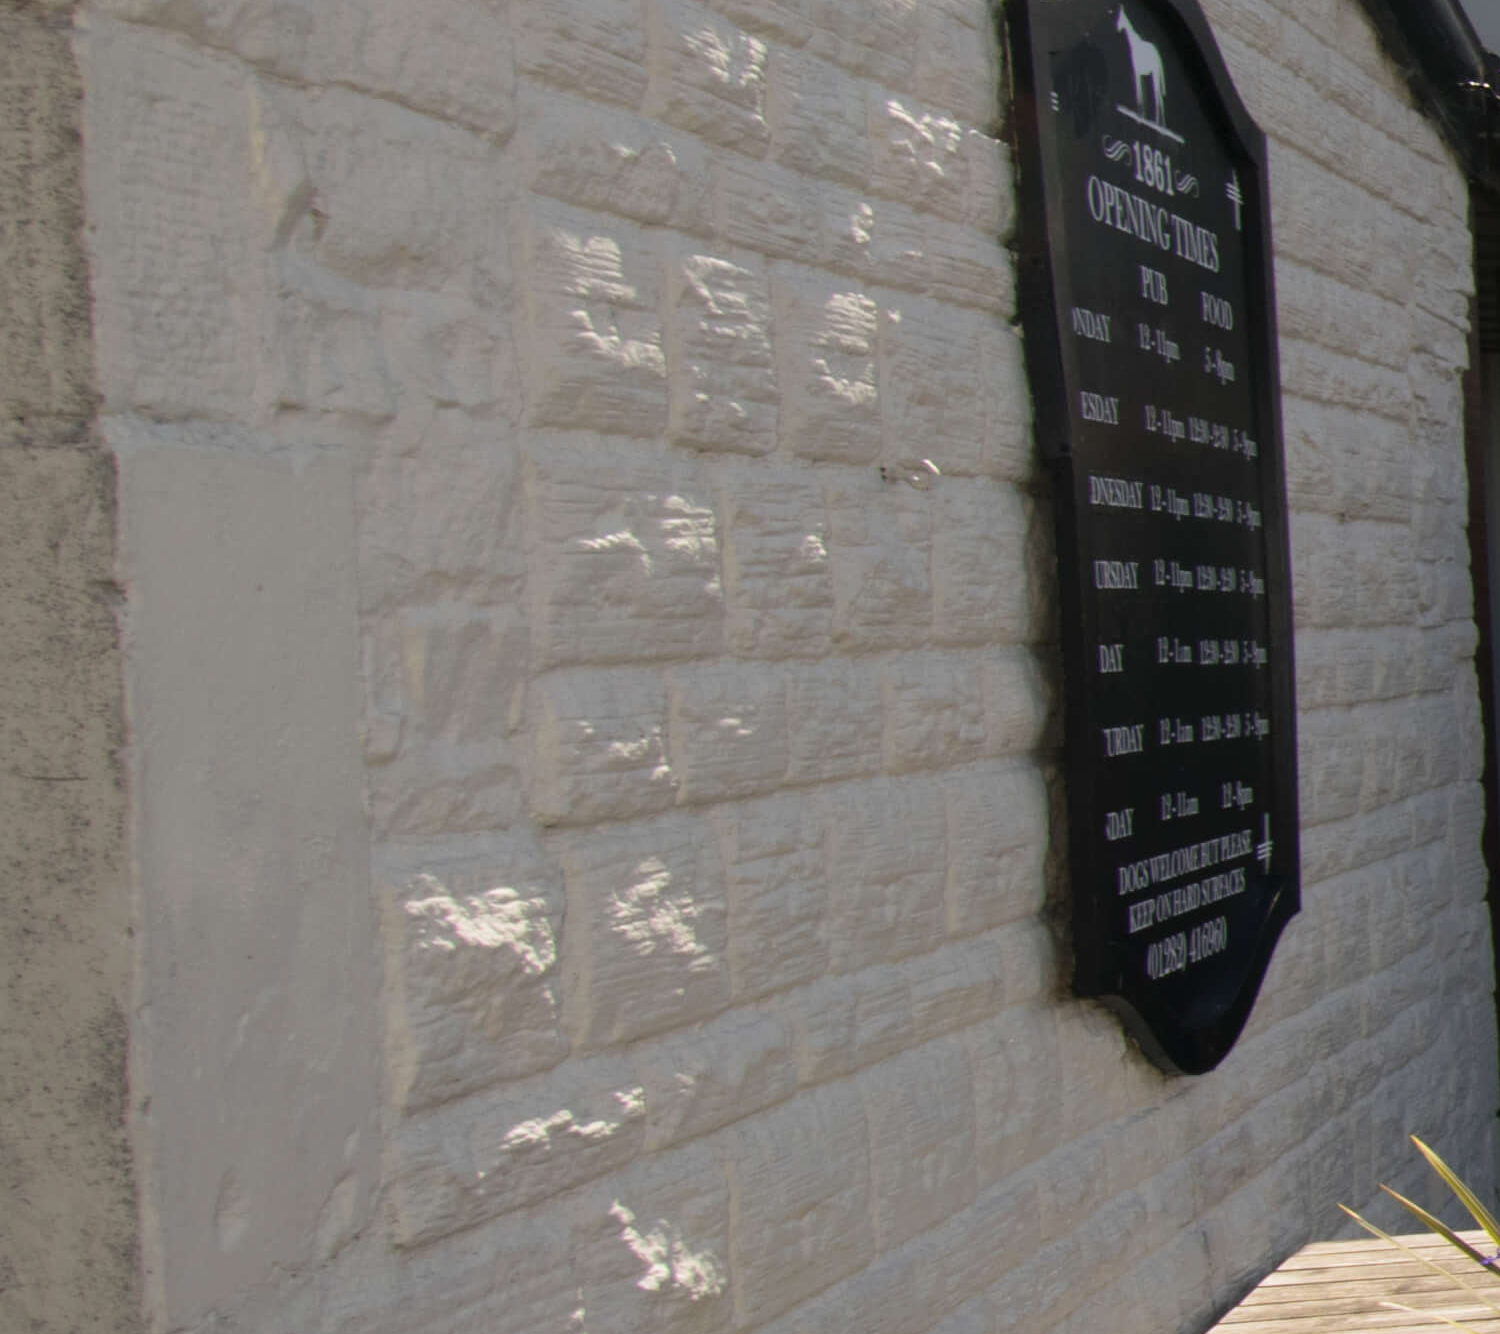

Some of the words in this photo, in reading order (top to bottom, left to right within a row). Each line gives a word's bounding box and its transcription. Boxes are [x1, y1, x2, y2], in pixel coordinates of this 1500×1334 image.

[1133, 140, 1175, 196] 1861
[1087, 175, 1171, 251] OPENING
[1171, 213, 1220, 273] TIMES
[1139, 265, 1168, 305] PUB
[1201, 291, 1234, 331] FOOD
[1072, 306, 1112, 343] NDAY
[1080, 390, 1120, 425] ESDAY
[1089, 475, 1144, 509] DNESDAY
[1094, 560, 1139, 590] URSDAY
[1098, 643, 1125, 674] DAY
[1103, 724, 1144, 757] URDAY
[1150, 843, 1199, 883] WELCOME
[1200, 837, 1220, 868] BUT
[1221, 829, 1253, 862] PLEASE
[1129, 898, 1156, 933] KEEP
[1156, 891, 1173, 923] ON
[1173, 882, 1201, 916] HARD
[1201, 867, 1246, 906] SURFACES
